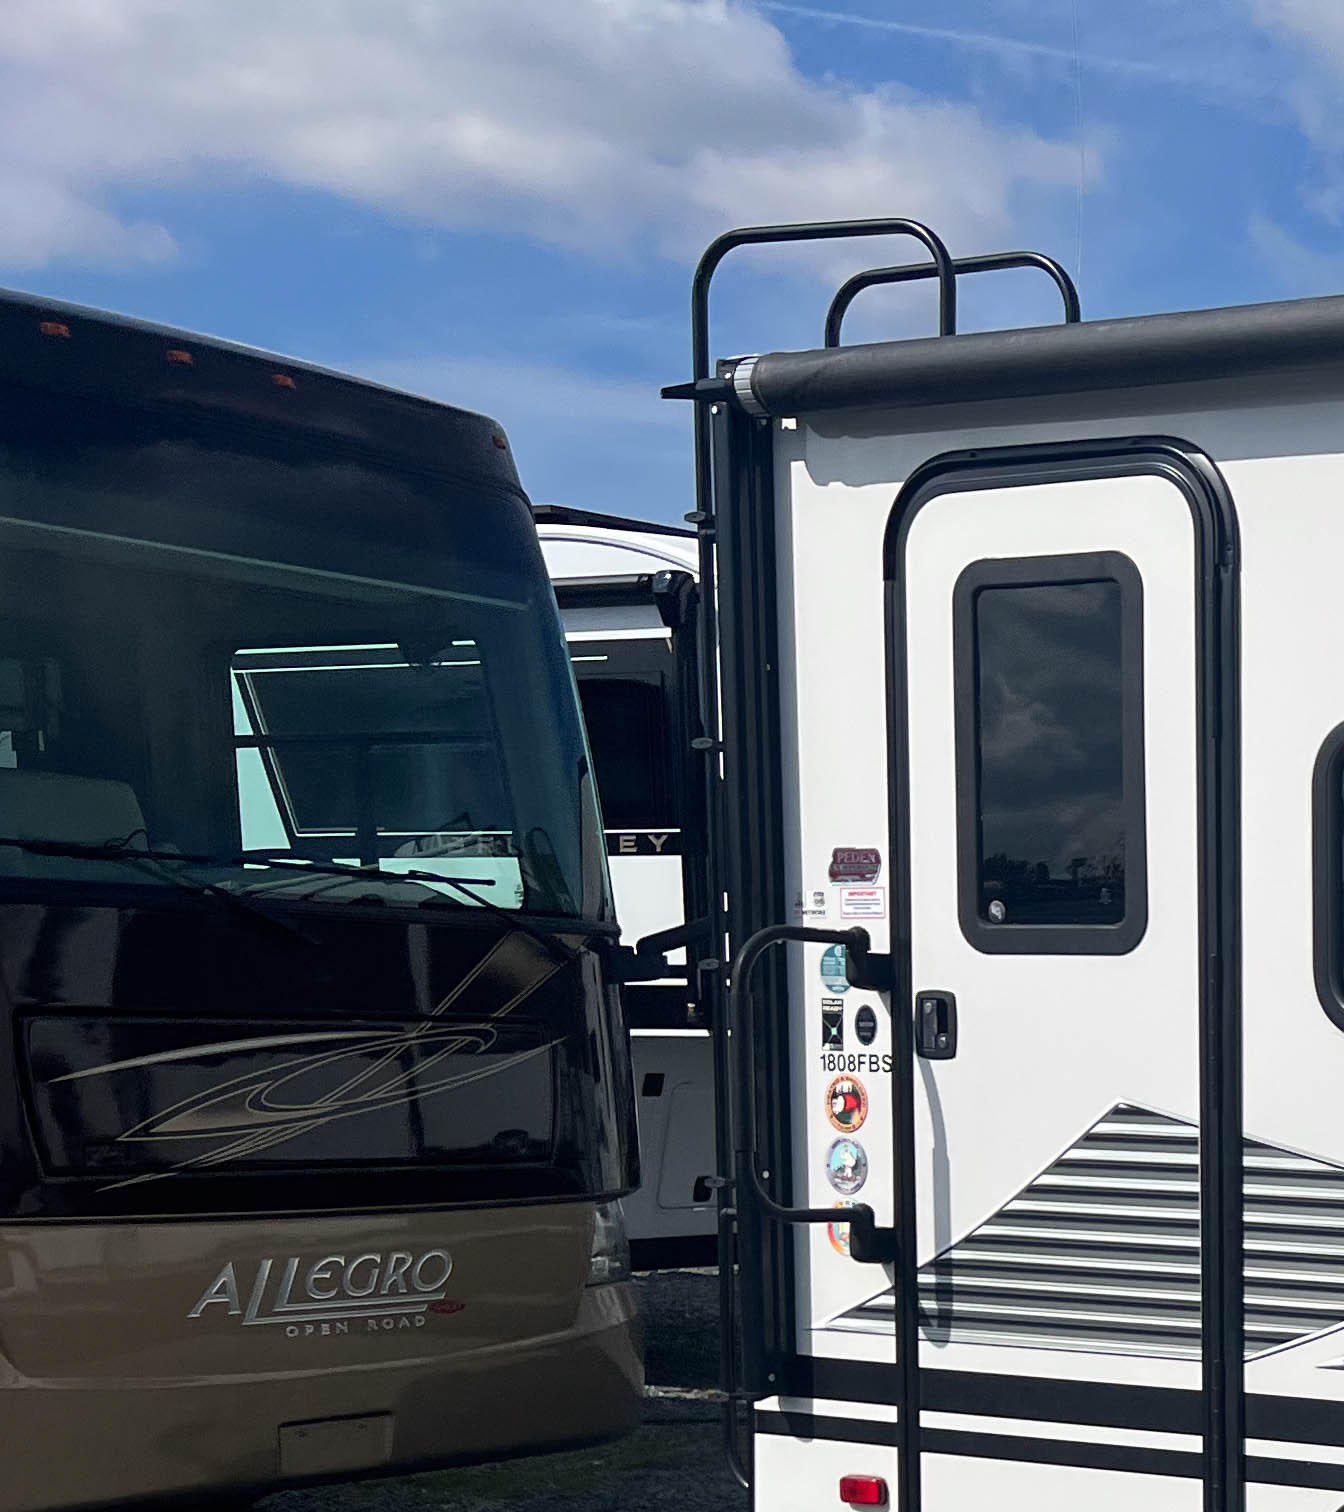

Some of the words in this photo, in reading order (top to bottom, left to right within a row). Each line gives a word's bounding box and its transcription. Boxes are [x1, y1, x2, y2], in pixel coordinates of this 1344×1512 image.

[836, 851, 876, 863] PEDEN
[820, 1053, 892, 1073] 1808FBS
[187, 1249, 454, 1326] ALLEGRO
[286, 1321, 349, 1338] OPEN
[367, 1315, 426, 1332] ROAD
